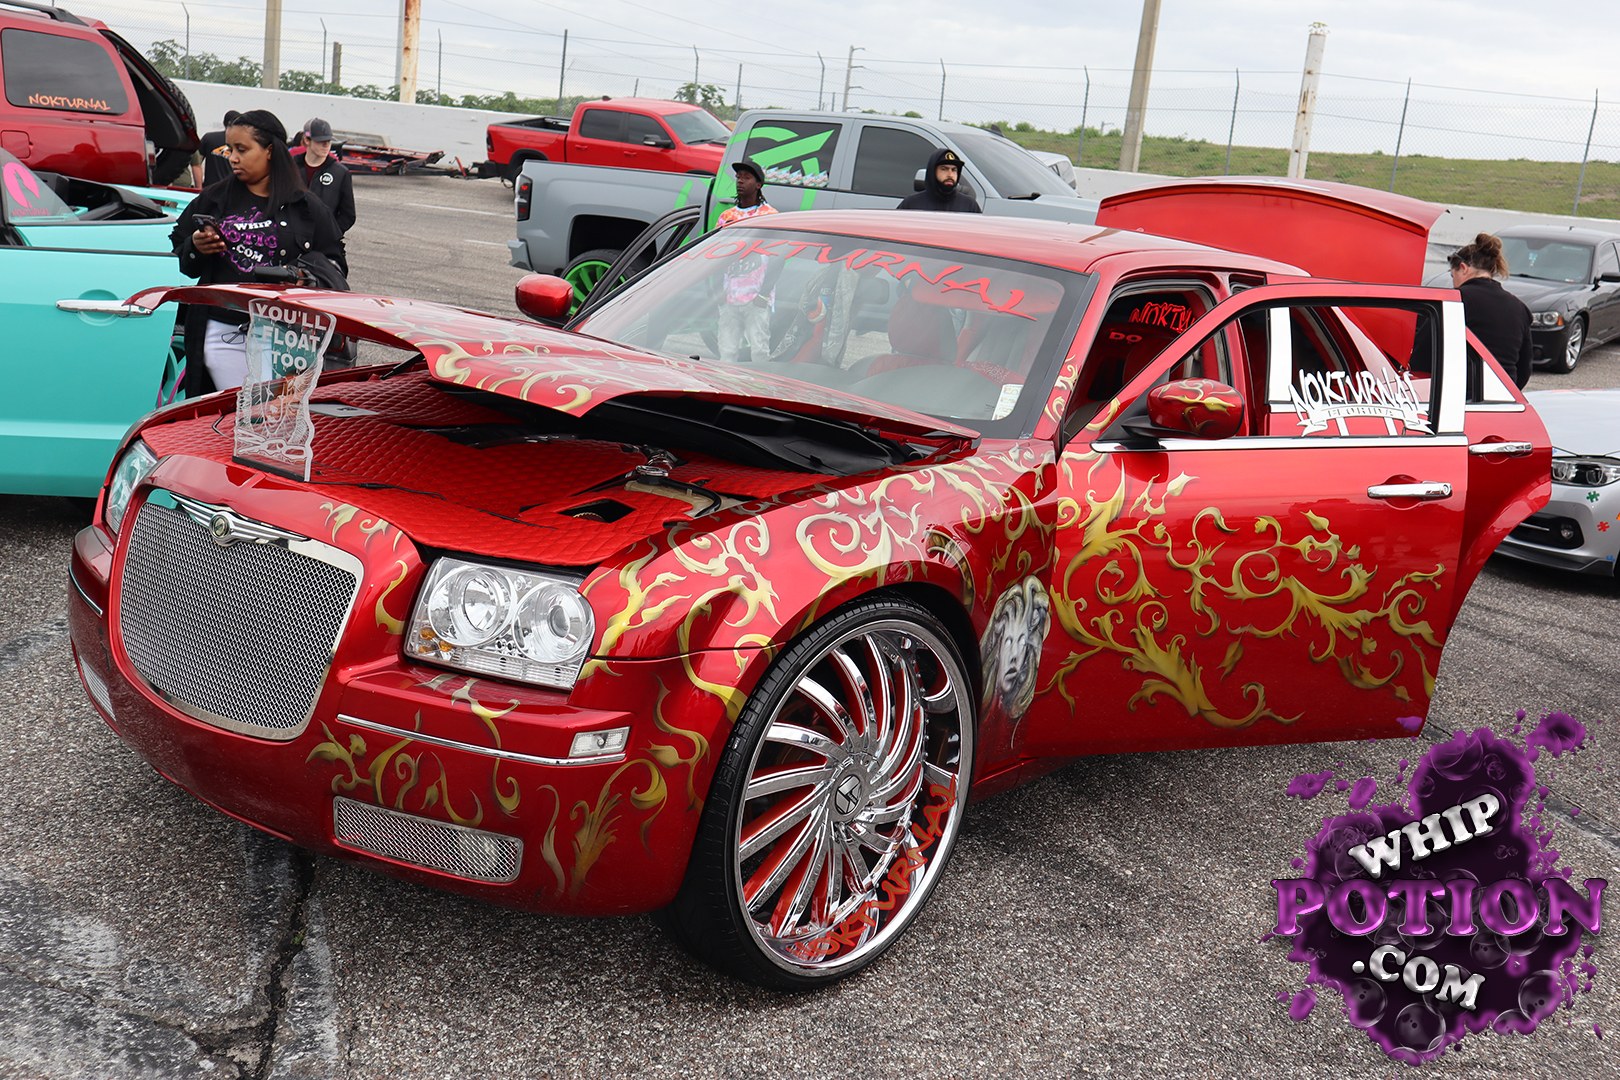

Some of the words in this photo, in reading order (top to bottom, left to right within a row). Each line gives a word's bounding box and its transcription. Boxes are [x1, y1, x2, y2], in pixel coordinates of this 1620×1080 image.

[28, 93, 111, 111] NOKTURNAL
[233, 219, 272, 231] WHIP
[224, 229, 278, 249] OTIO
[231, 244, 264, 263] .COM
[669, 239, 1038, 321] NOKTURNAL
[255, 302, 328, 331] YOU'LL
[262, 325, 321, 353] FLOAT
[271, 350, 307, 372] TOO
[1288, 367, 1428, 422] NOKTURNAL
